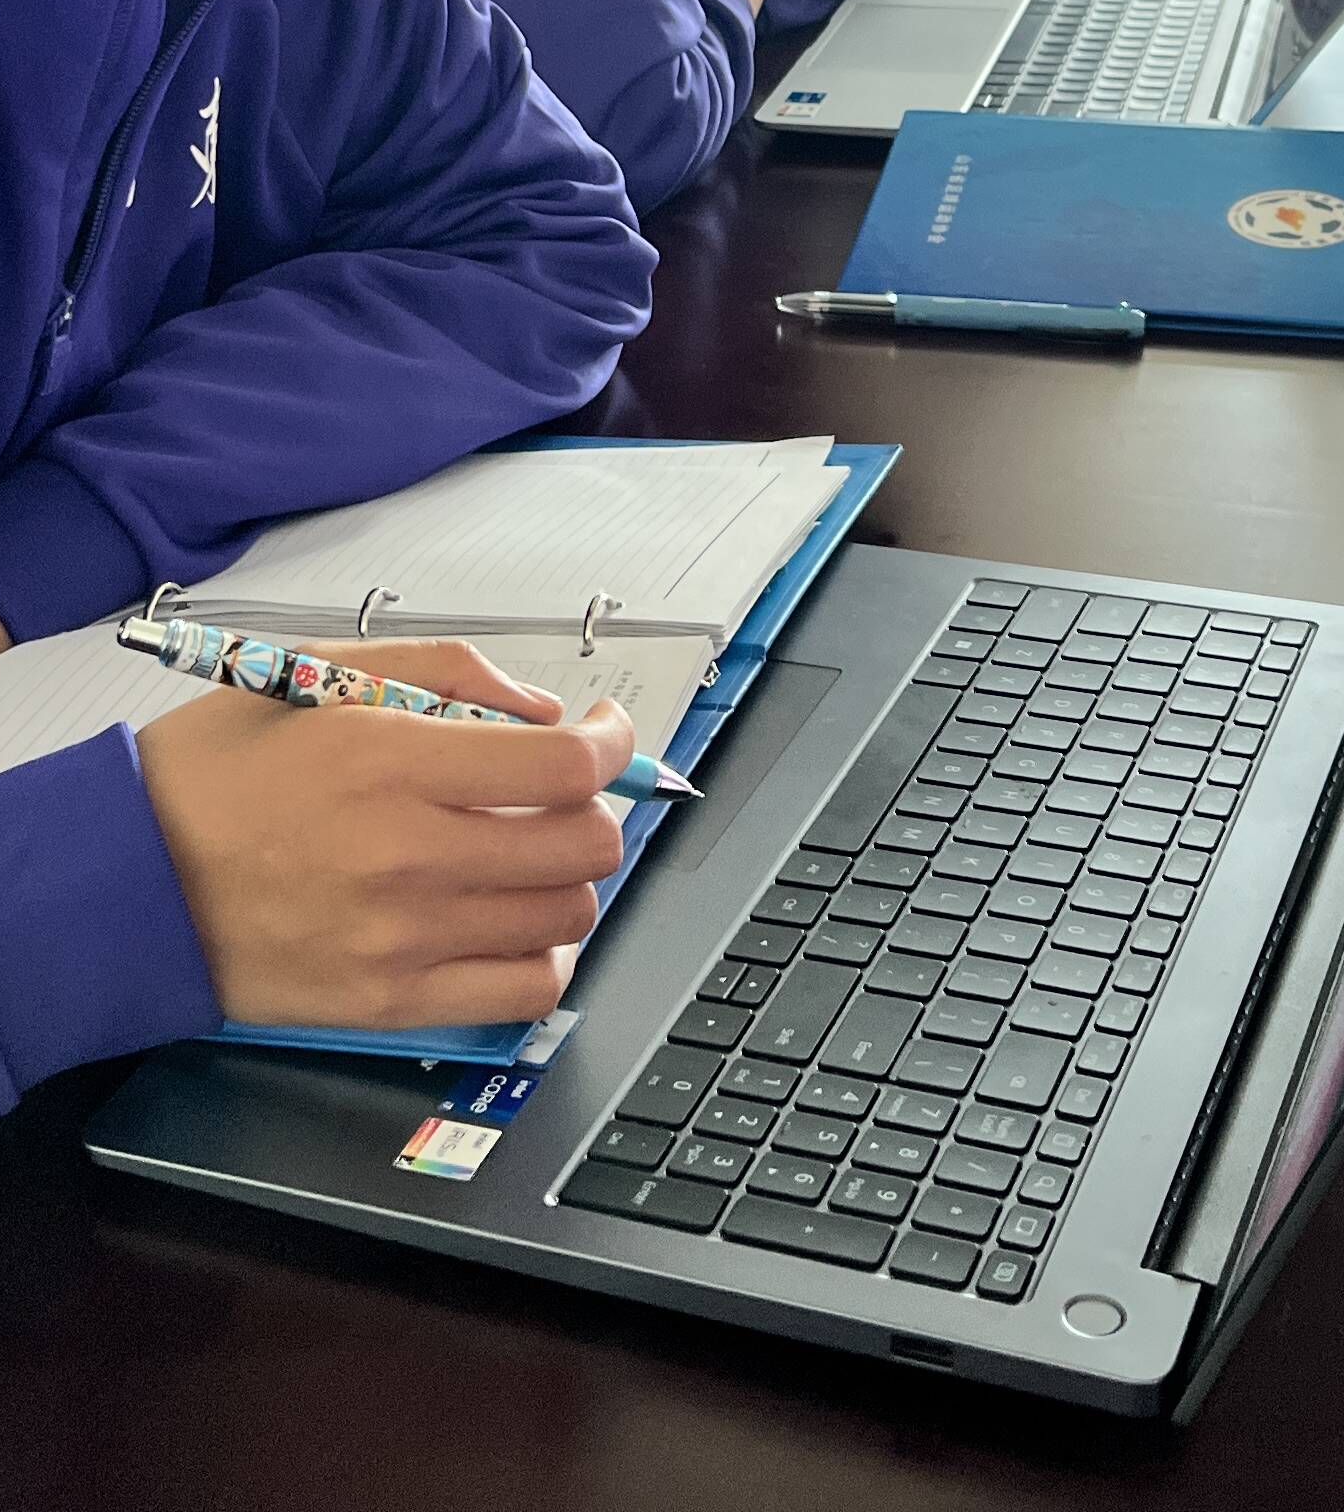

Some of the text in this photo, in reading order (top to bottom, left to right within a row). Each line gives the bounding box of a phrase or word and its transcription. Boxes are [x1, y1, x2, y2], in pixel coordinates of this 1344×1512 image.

[673, 1080, 692, 1091] 0
[840, 1091, 859, 1102] 4
[921, 1107, 941, 1119] 7
[737, 1115, 758, 1126] 2
[818, 1130, 839, 1142] 5
[898, 1147, 919, 1159] 8
[713, 1155, 734, 1167] 3
[794, 1173, 815, 1185] 6
[877, 1189, 898, 1201] 9
